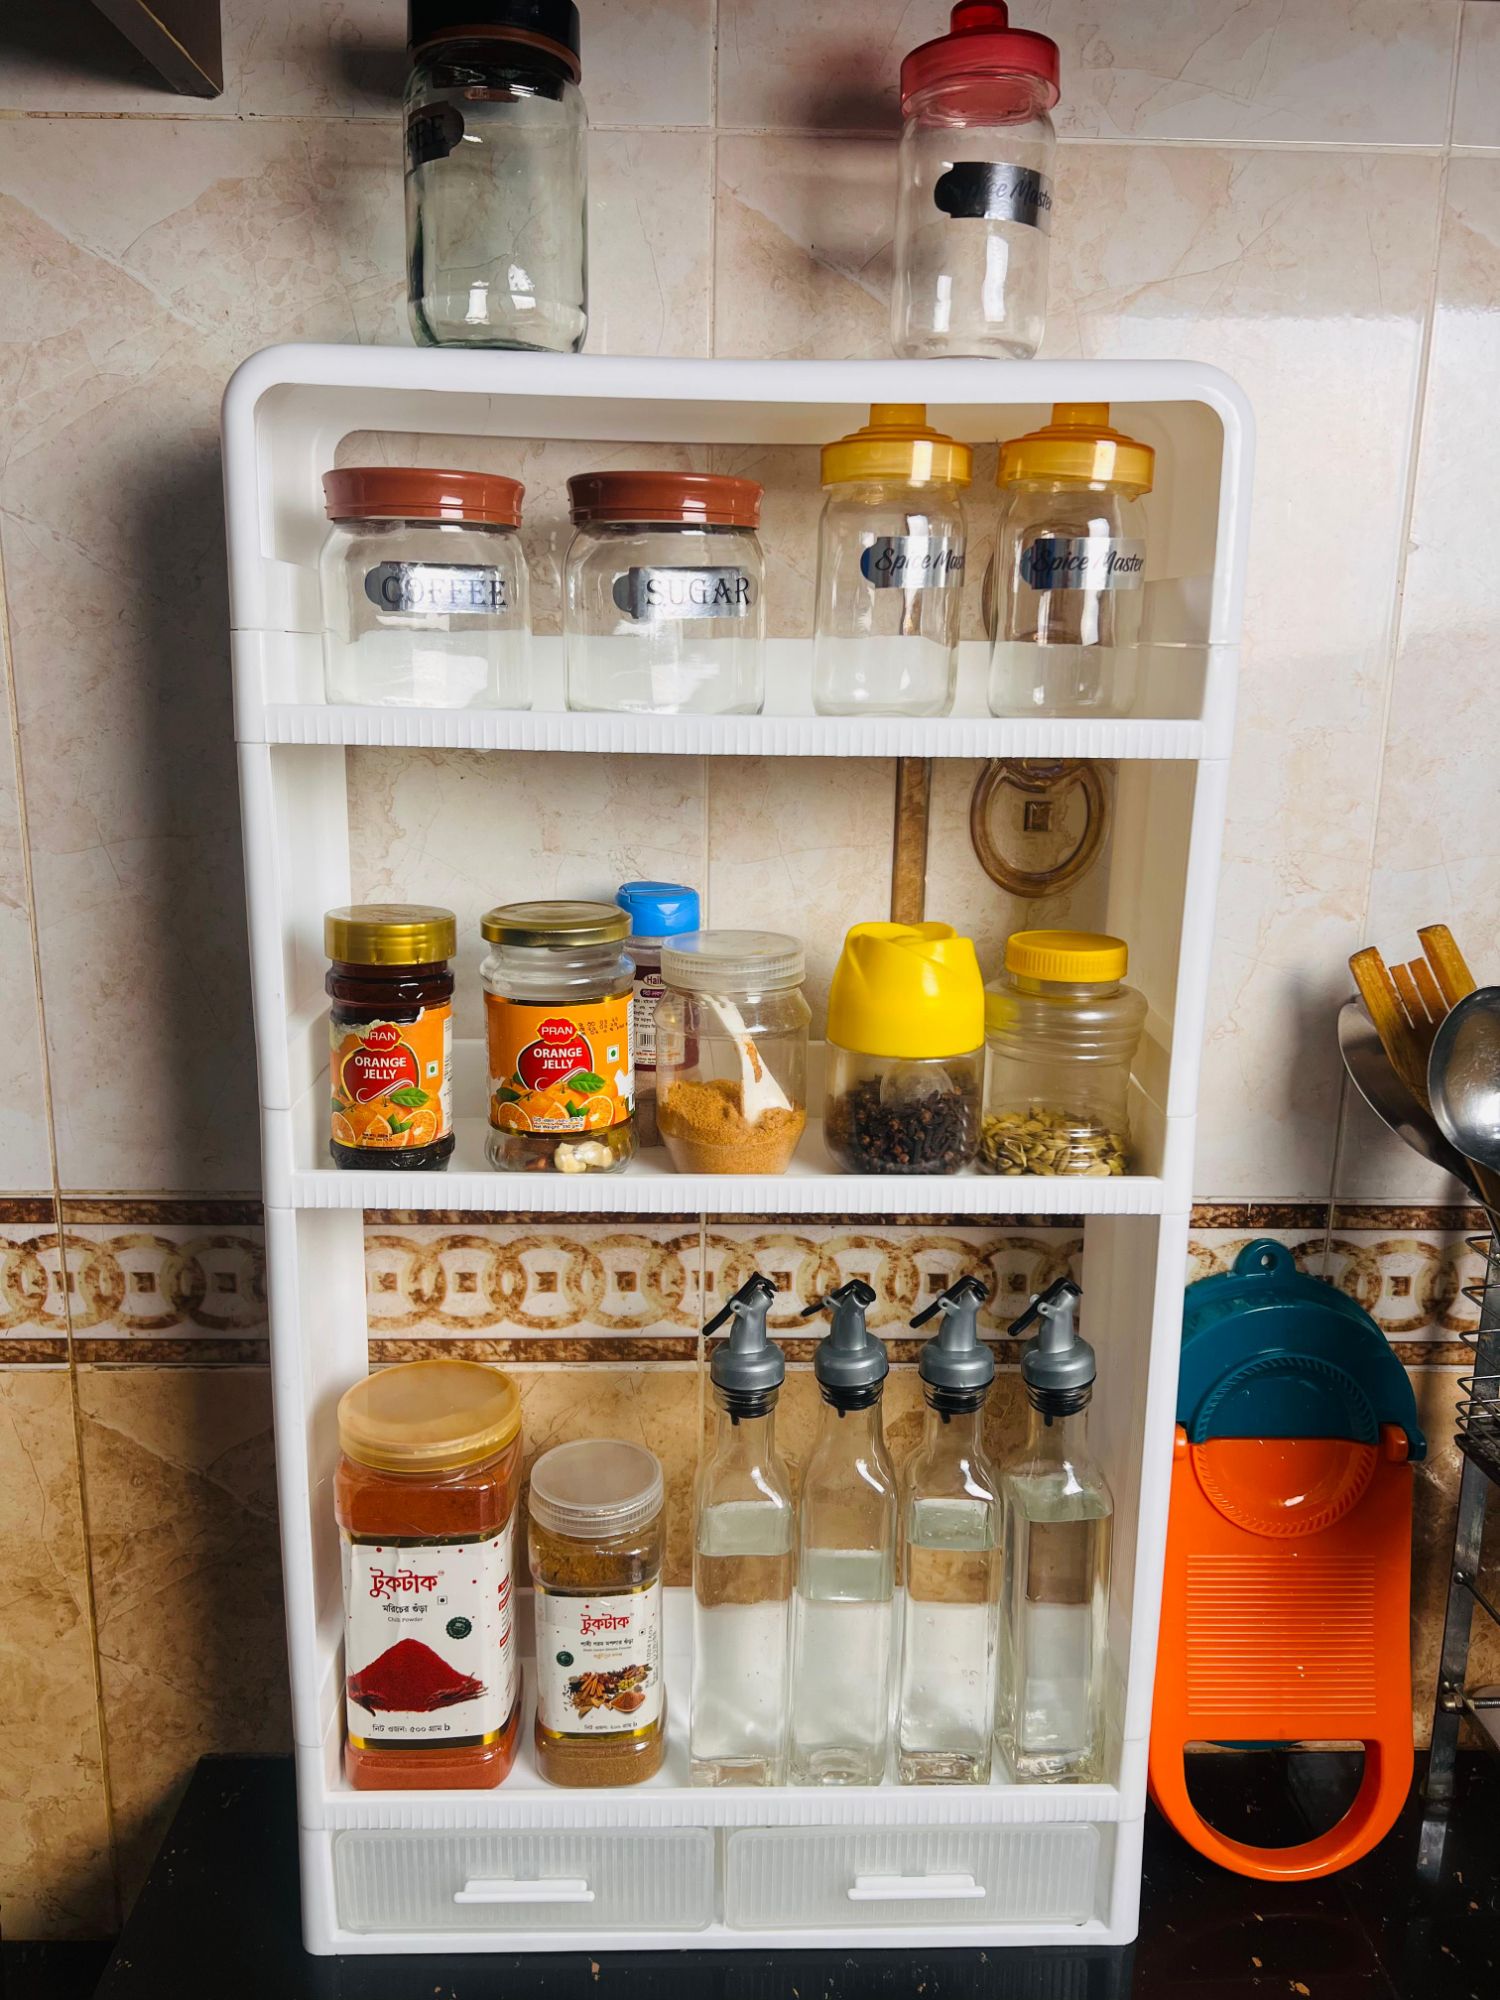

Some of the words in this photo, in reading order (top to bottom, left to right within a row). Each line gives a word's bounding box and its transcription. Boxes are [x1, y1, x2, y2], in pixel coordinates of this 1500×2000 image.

[1032, 548, 1088, 577] Spice
[382, 576, 507, 606] COFFEE
[646, 577, 751, 605] SUGAR
[646, 975, 664, 984] Haik
[370, 1032, 396, 1041] RAN
[541, 1027, 573, 1035] PRAN
[533, 1047, 583, 1058] ORANGE
[354, 1056, 407, 1067] ORANGE
[542, 1060, 574, 1069] JELLY
[363, 1069, 397, 1080] JELLY
[369, 1567, 438, 1599] টুকটাক
[580, 1613, 630, 1636] টুকটাক
